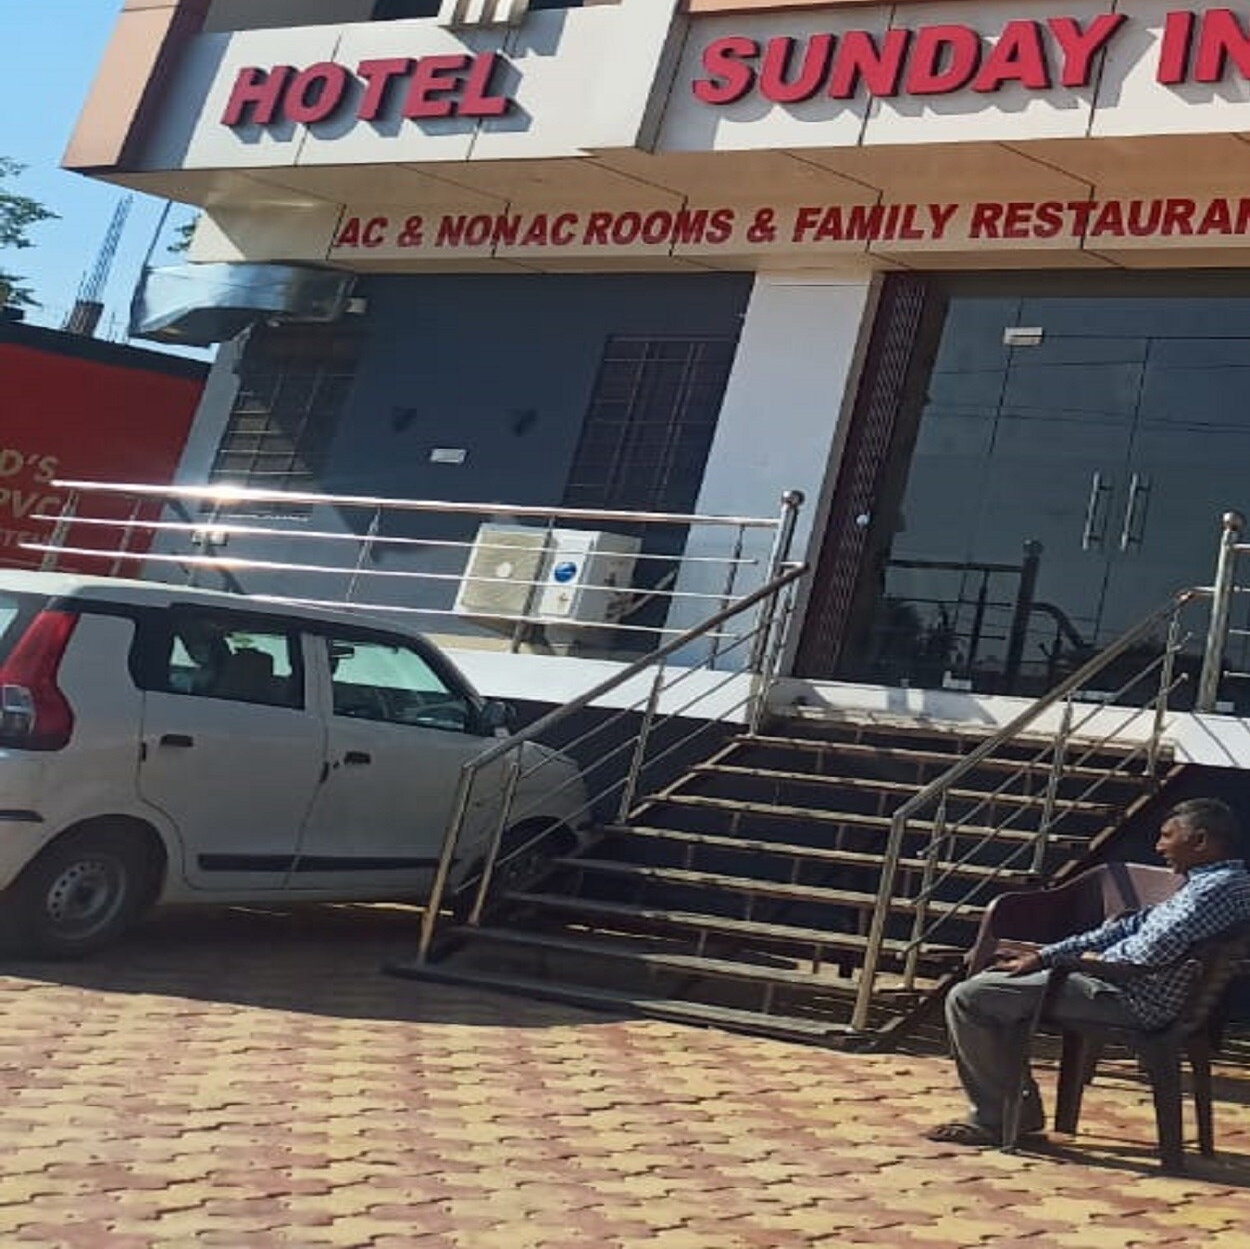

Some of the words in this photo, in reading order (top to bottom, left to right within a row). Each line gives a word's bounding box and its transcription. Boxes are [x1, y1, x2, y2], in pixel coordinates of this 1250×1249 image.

[221, 51, 512, 127] HOTEL
[692, 11, 1126, 105] SUNDAY
[336, 216, 388, 247] AC
[399, 215, 423, 247] &
[583, 208, 735, 245] ROOMS
[746, 208, 776, 243] &
[792, 203, 958, 243] FAMILY
